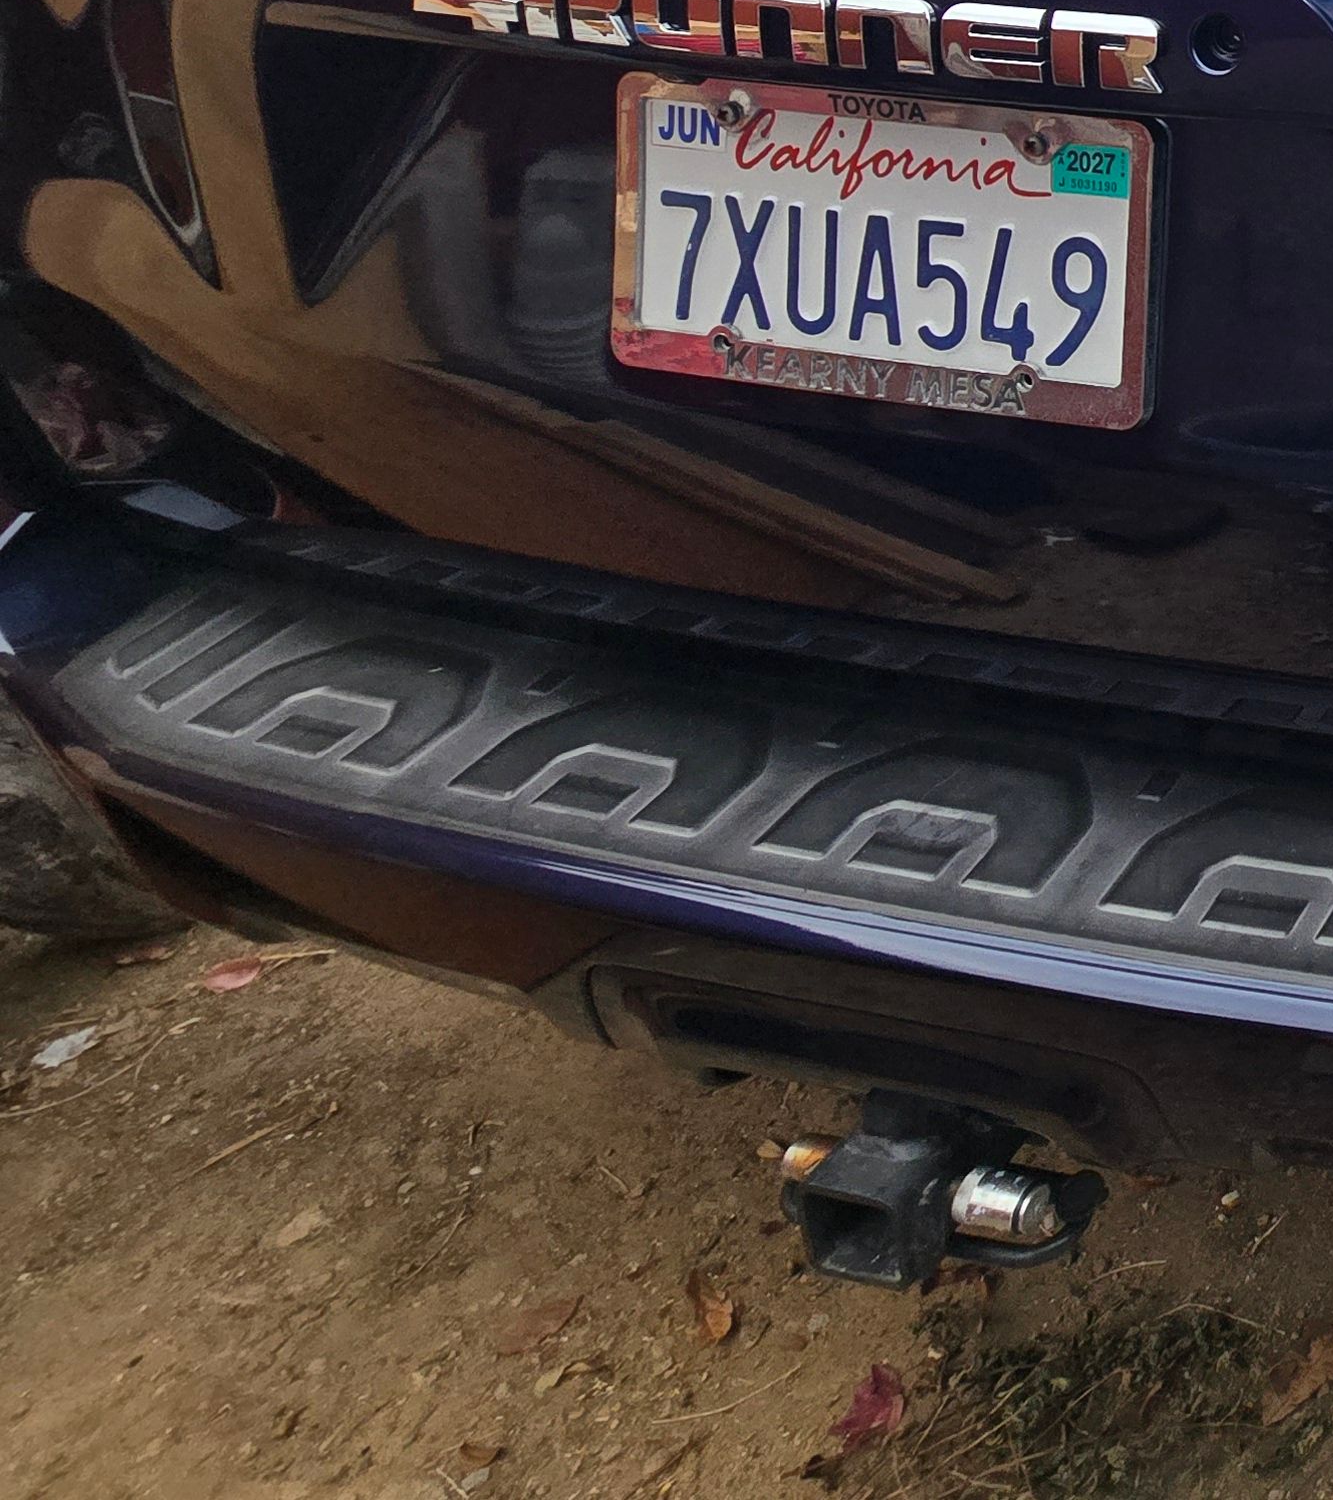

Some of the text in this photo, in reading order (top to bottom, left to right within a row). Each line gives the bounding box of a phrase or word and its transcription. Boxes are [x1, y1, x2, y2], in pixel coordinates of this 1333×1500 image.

[658, 104, 720, 146] JUN
[828, 94, 926, 122] TOYOTA
[735, 108, 1052, 199] California
[1066, 149, 1116, 175] 2027
[661, 189, 1108, 367] 7XUA549
[725, 341, 1026, 416] KEARNY MESA
